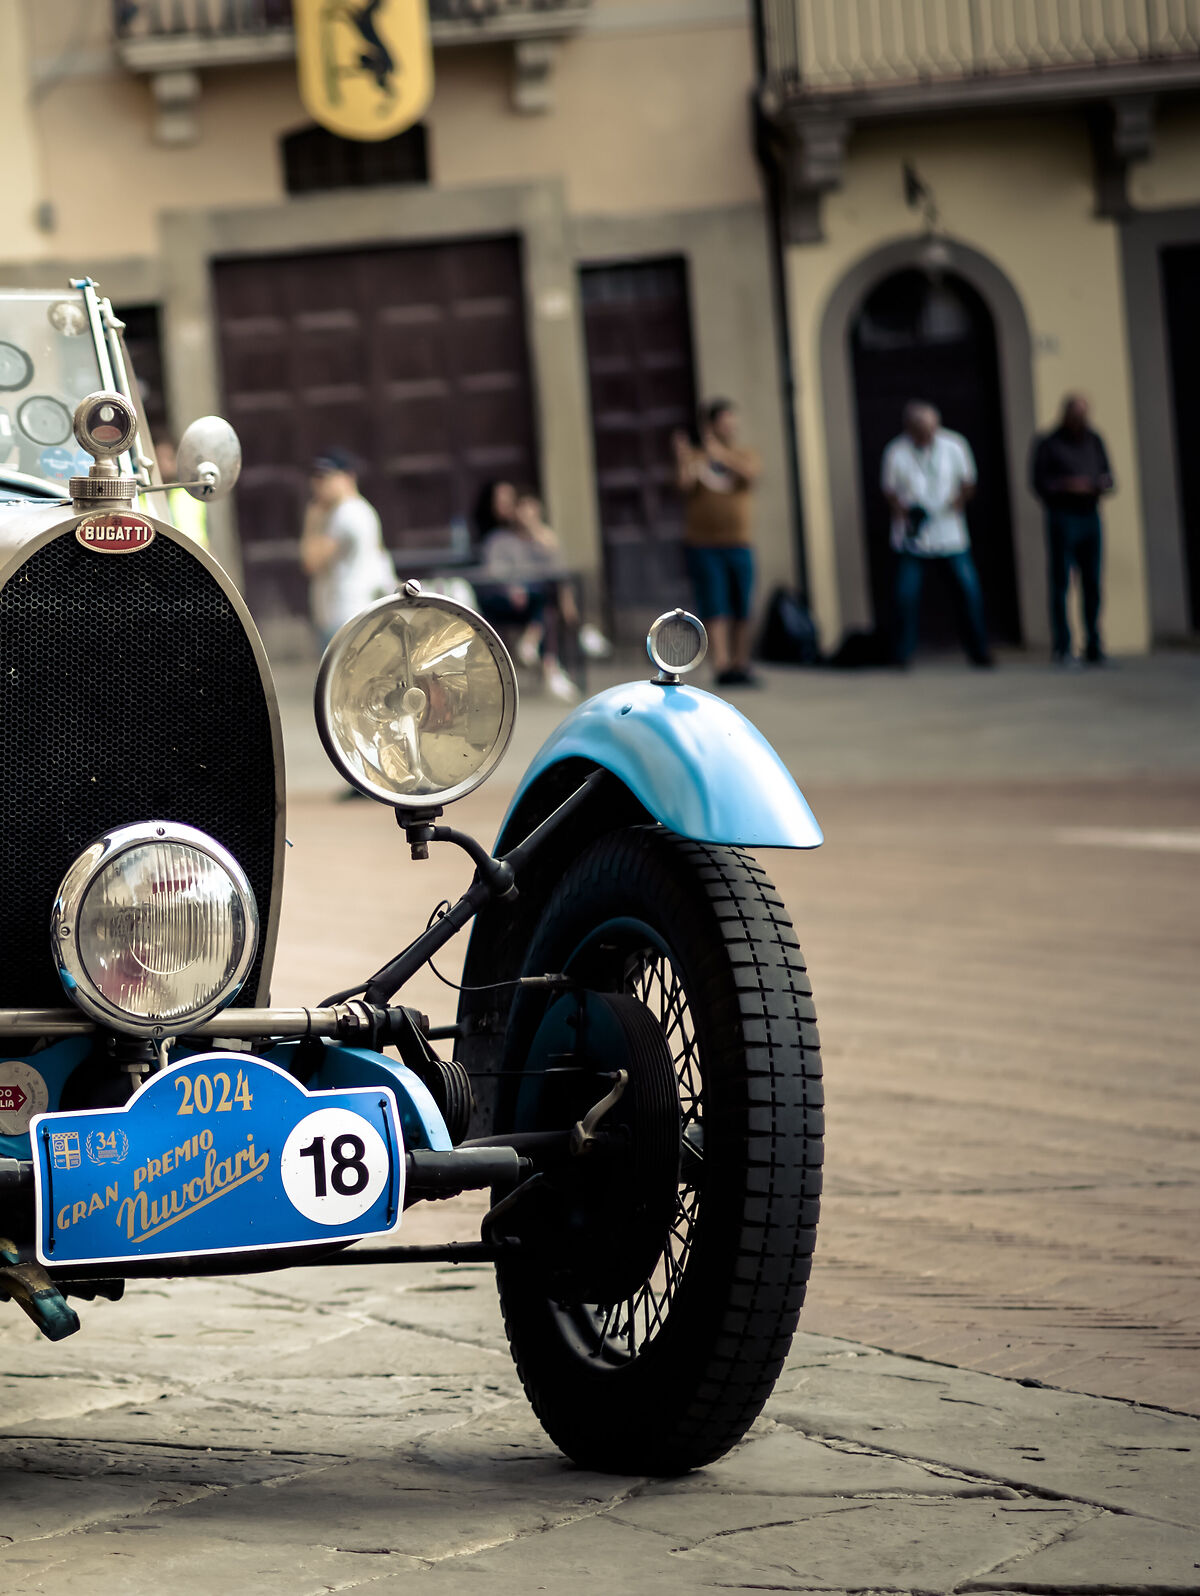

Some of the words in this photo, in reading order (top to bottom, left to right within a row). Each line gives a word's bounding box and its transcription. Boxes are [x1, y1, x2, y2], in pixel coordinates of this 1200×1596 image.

[85, 526, 148, 541] BUGATTI
[174, 1069, 254, 1116] 2024
[96, 1130, 117, 1150] 34
[300, 1133, 371, 1198] 18
[56, 1181, 120, 1230] GRAN
[133, 1129, 214, 1191] PREMIO
[116, 1133, 270, 1243] Nuvolari
